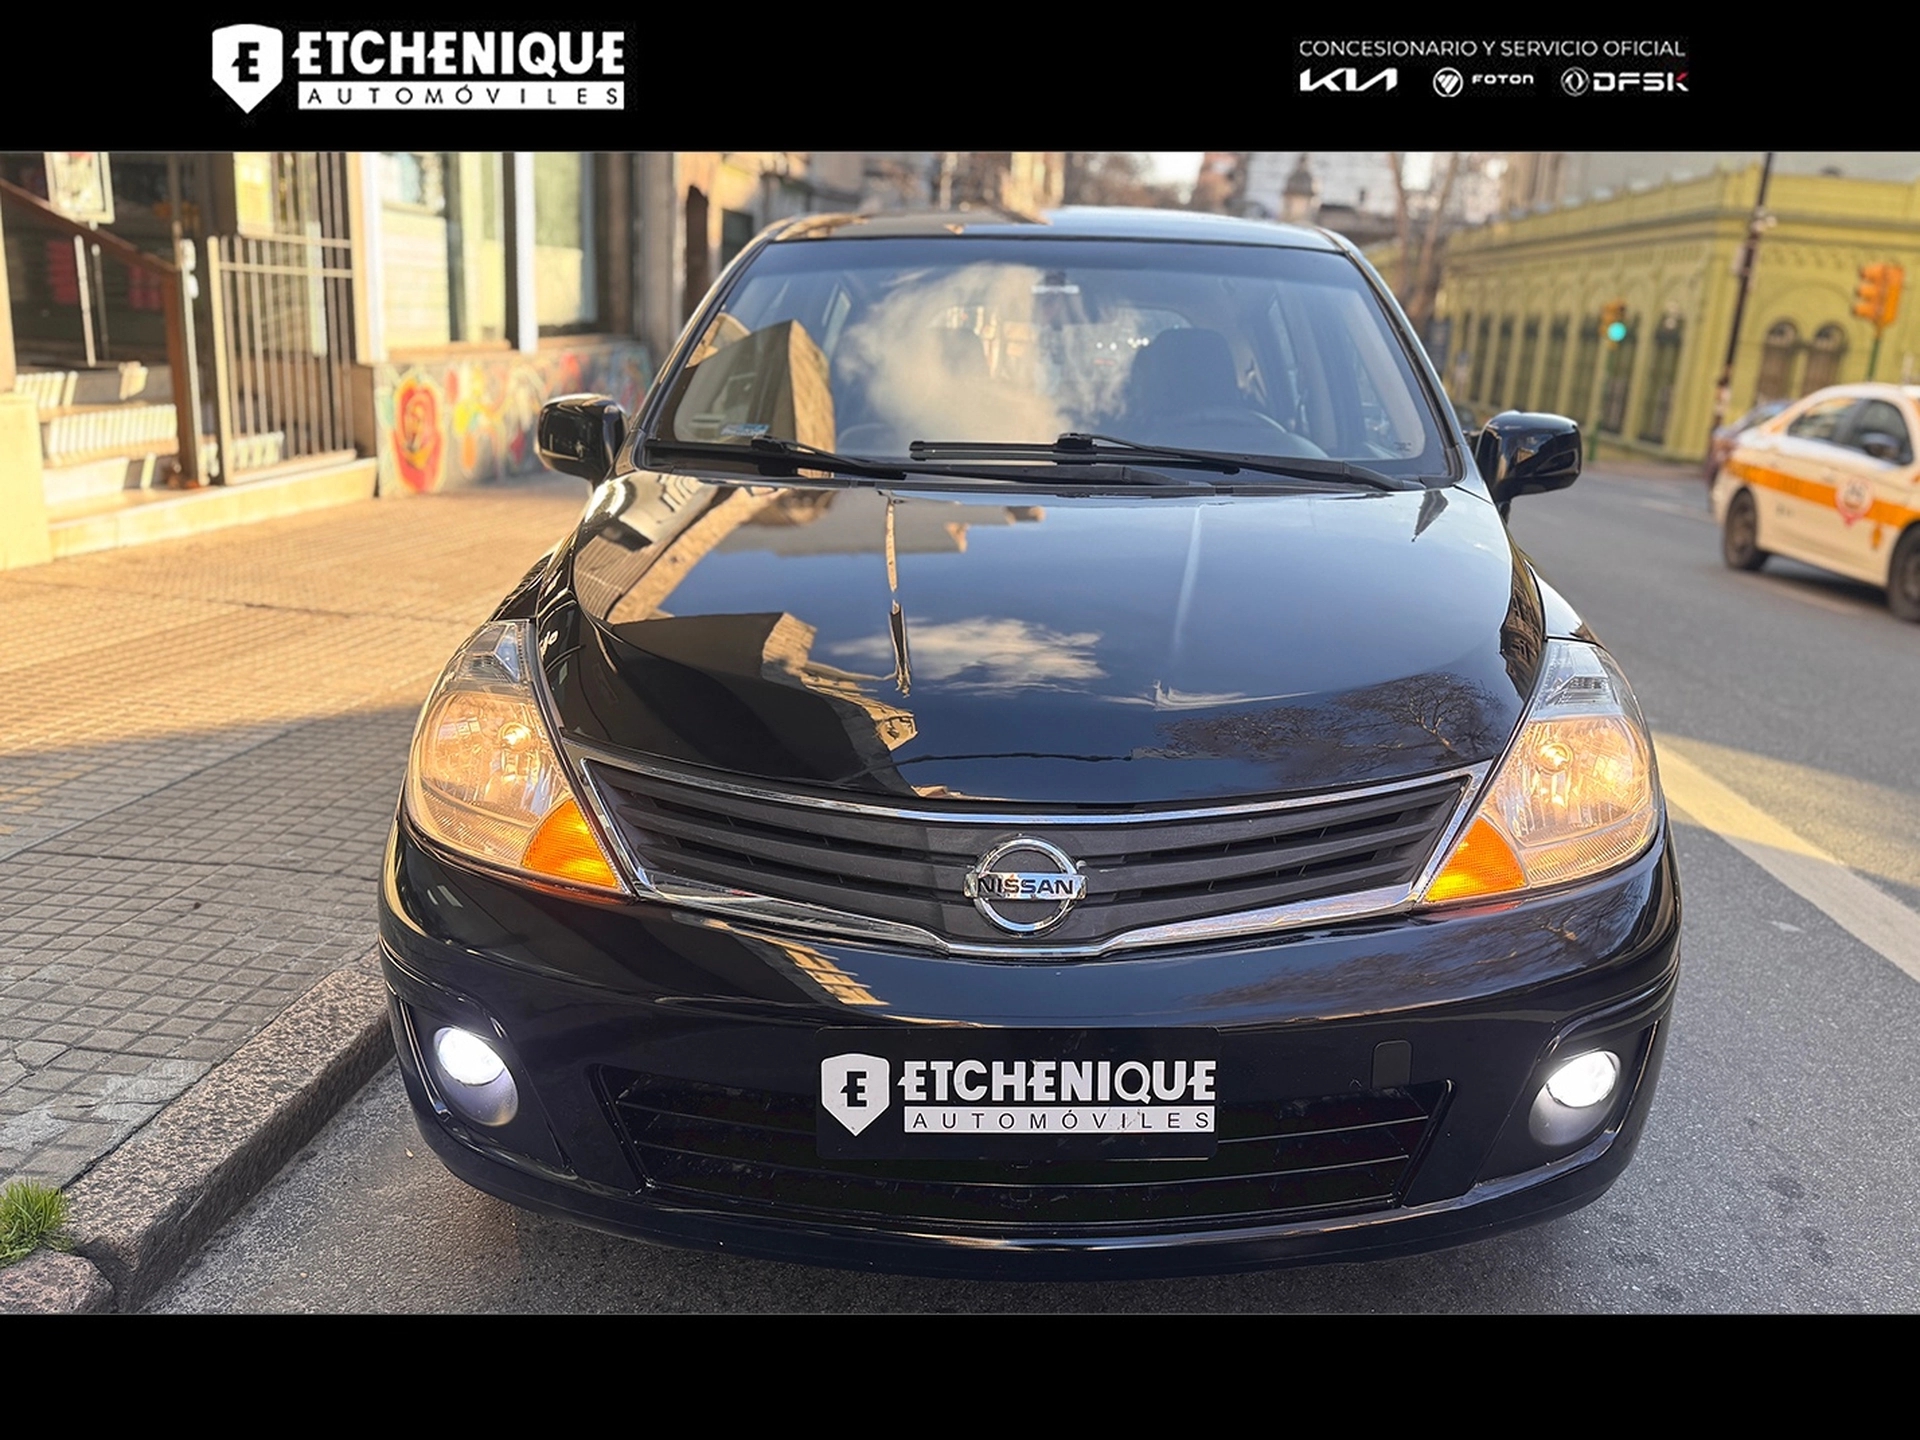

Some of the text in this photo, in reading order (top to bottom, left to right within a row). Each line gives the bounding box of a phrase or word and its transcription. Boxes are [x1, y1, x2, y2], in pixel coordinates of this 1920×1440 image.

[977, 877, 1074, 895] NISSAN
[897, 1059, 1217, 1104] ETCHENIQUE
[912, 1109, 1209, 1130] AUTOMÓVILES
